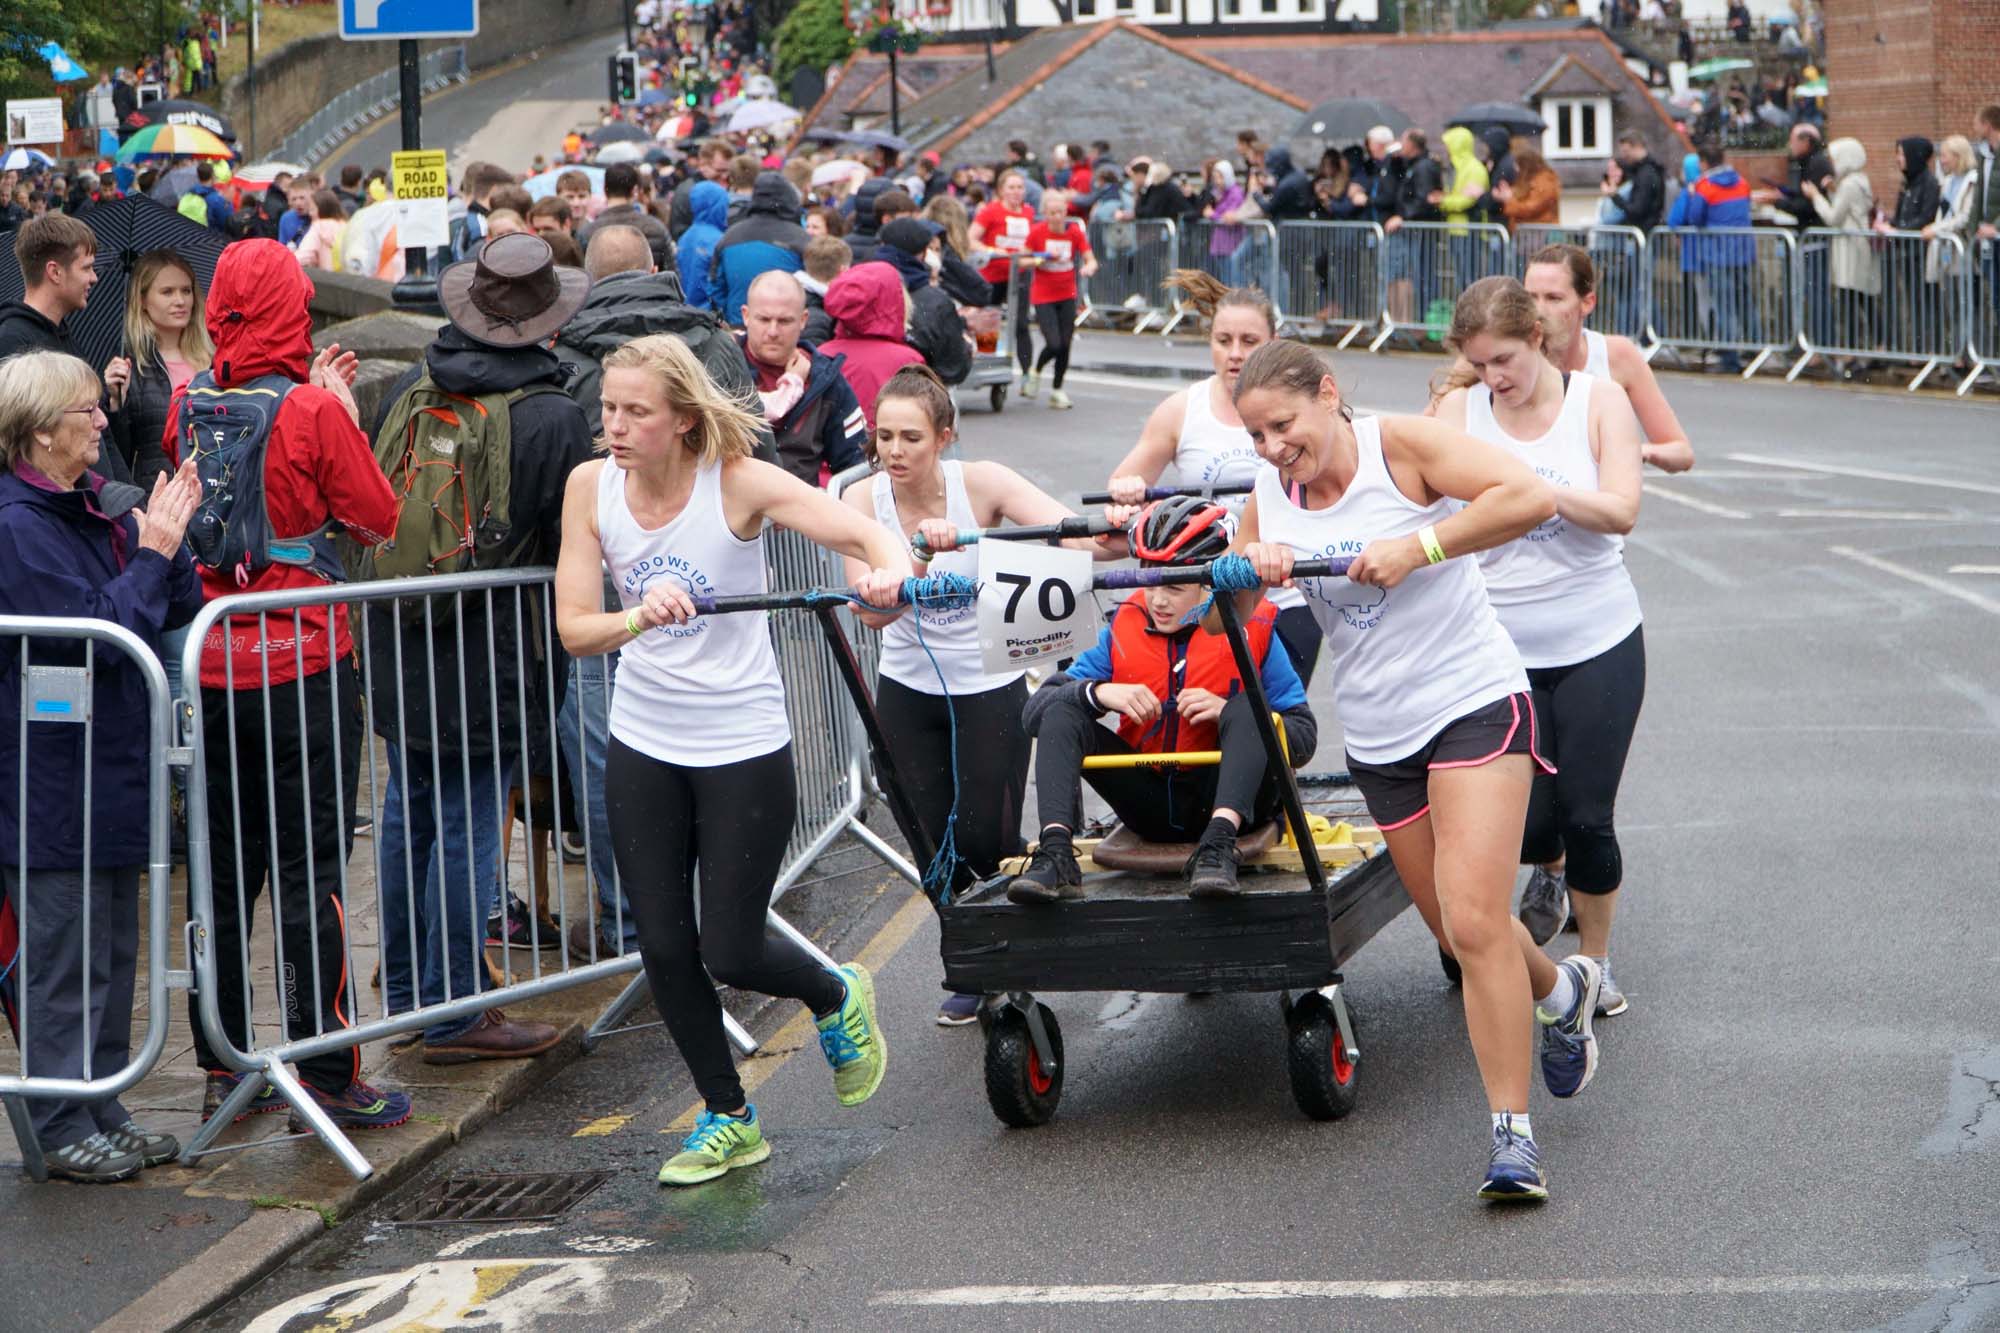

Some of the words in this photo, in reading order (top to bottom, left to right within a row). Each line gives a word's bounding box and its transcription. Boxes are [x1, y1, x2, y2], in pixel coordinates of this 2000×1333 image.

[404, 171, 437, 184] ROAD
[398, 186, 445, 199] CLOSED
[996, 572, 1075, 623] 70
[655, 620, 709, 638] CADEMY
[1006, 630, 1072, 647] Piccadilly
